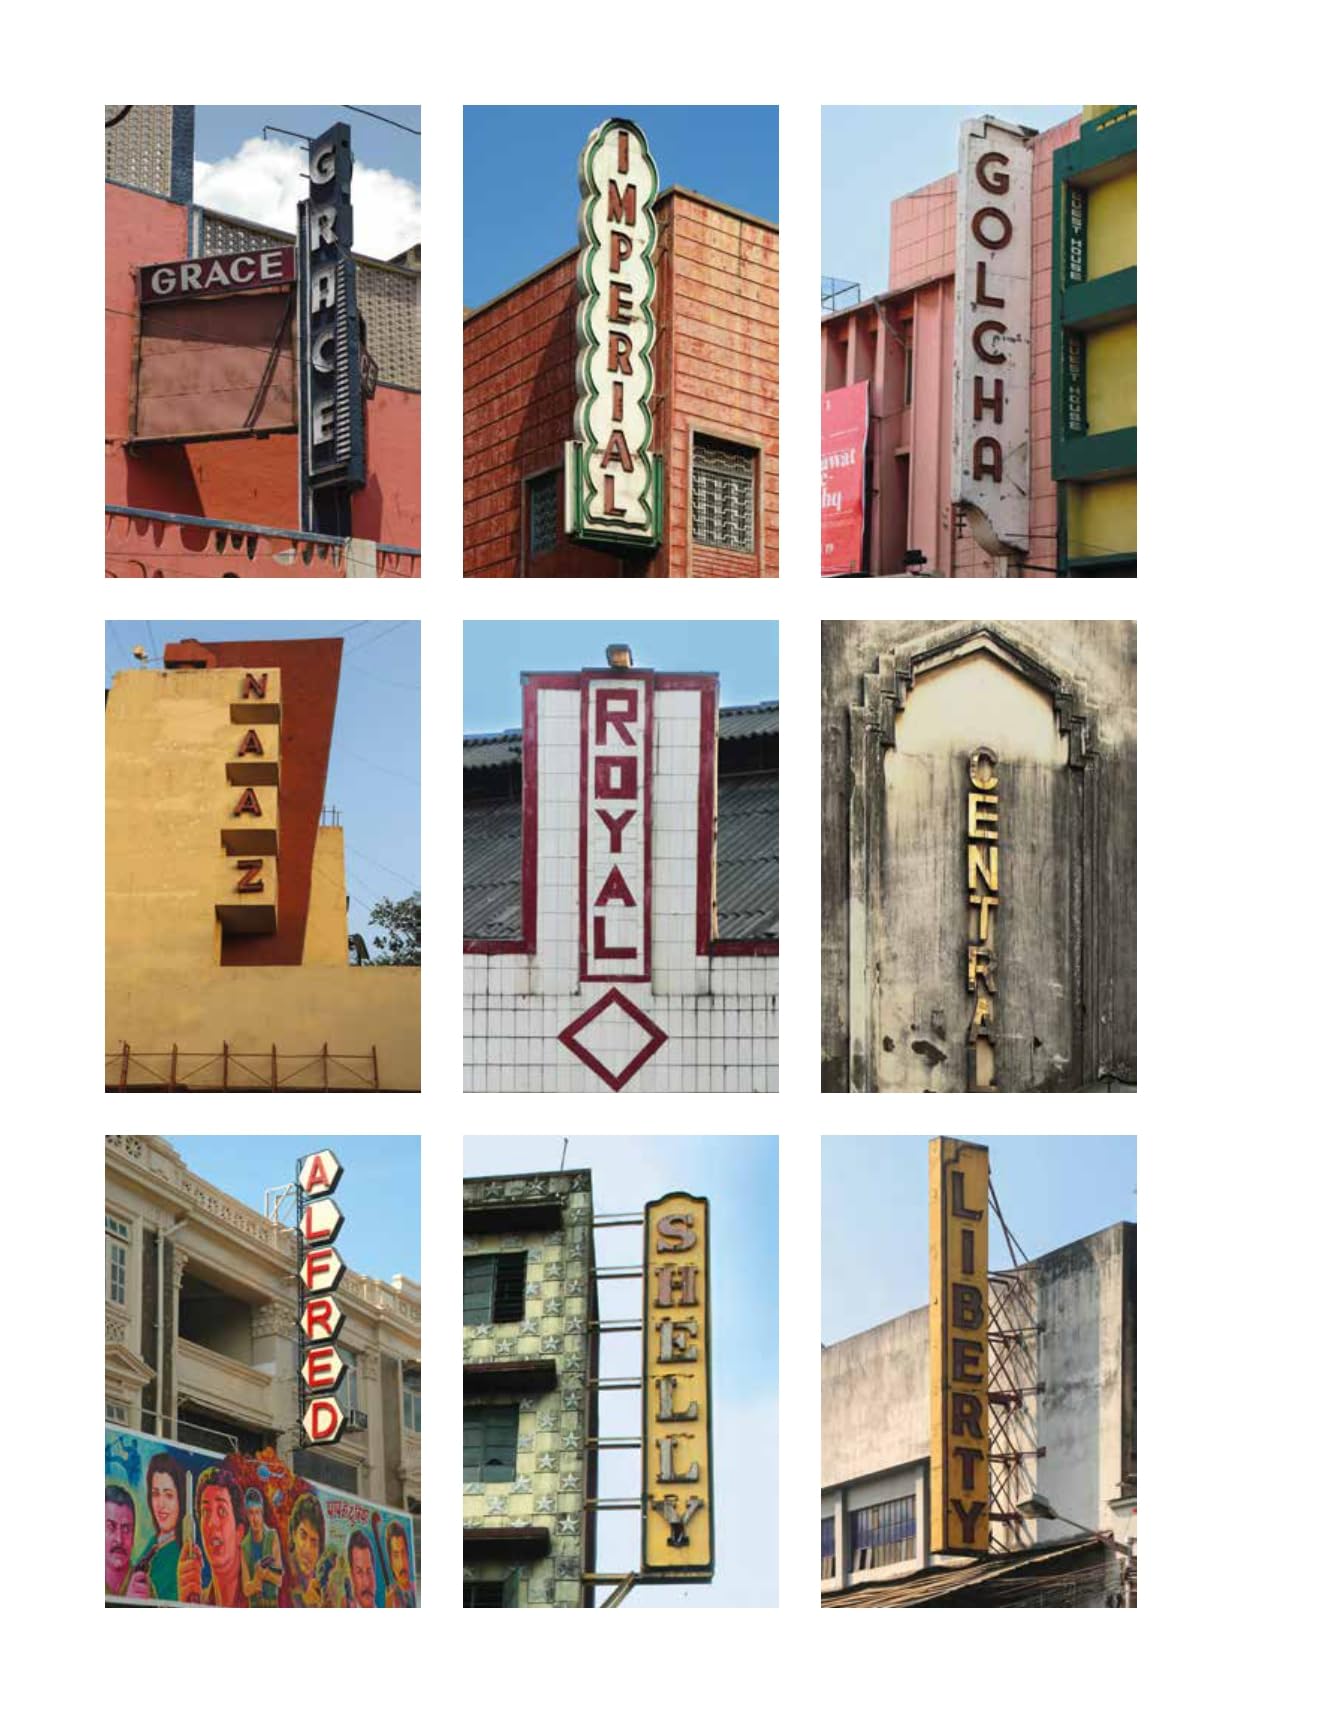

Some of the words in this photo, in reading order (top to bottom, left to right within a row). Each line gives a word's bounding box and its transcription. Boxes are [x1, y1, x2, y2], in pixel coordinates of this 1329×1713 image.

[151, 251, 283, 295] GRACE
[310, 144, 336, 446] GRACE
[600, 130, 636, 517] IMPERIAL
[971, 151, 1013, 483] GOLCHA
[234, 673, 269, 894] NAAZ
[594, 688, 639, 960] ROYAL
[304, 1155, 339, 1440] ALFRED
[652, 1213, 705, 1547] SHELLY
[950, 1169, 986, 1544] LIBERTY
